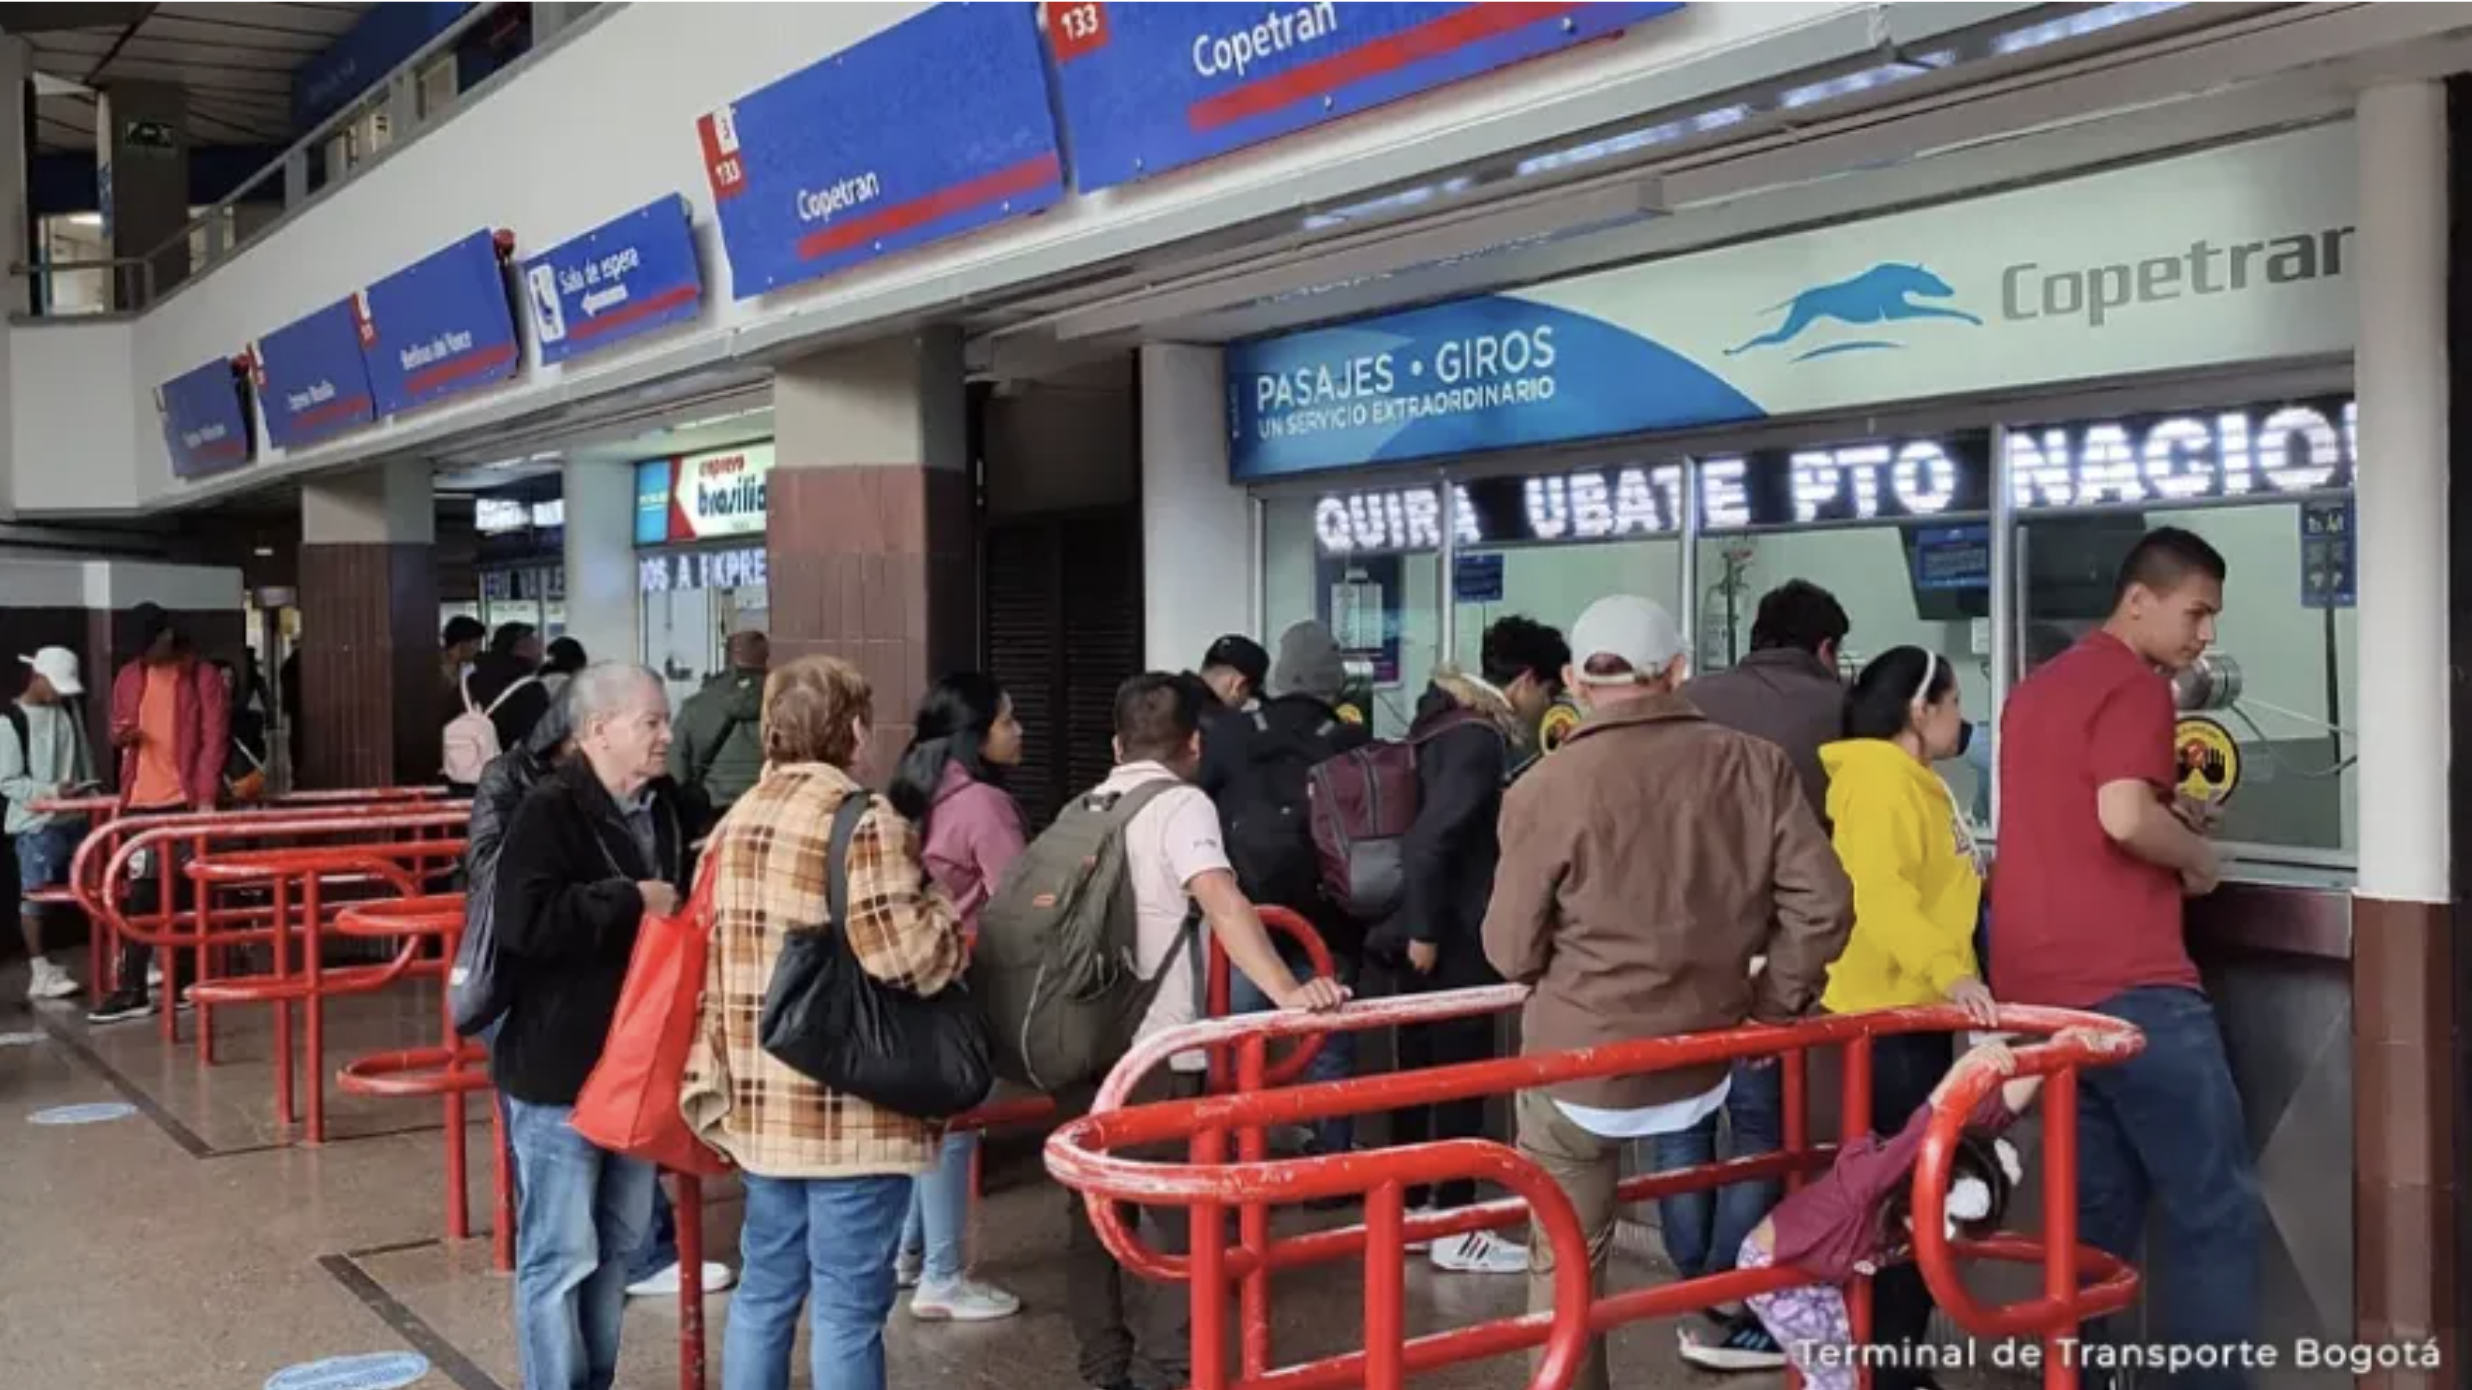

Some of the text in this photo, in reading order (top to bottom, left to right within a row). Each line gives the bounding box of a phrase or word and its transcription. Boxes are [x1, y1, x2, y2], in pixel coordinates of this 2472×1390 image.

[1060, 4, 1099, 41] 133
[1193, 2, 1337, 77] Copetran
[715, 158, 742, 187] 133
[798, 172, 880, 222] Copetran
[559, 246, 639, 295] Sala de espera
[1257, 354, 1394, 411] PASAJES
[1435, 325, 1555, 383] GIROS
[1258, 376, 1555, 440] UN SERVICIO EXTRAORDINARIO
[1315, 401, 2358, 553] QUIRA UBATE PTO NACIO
[677, 555, 692, 589] A
